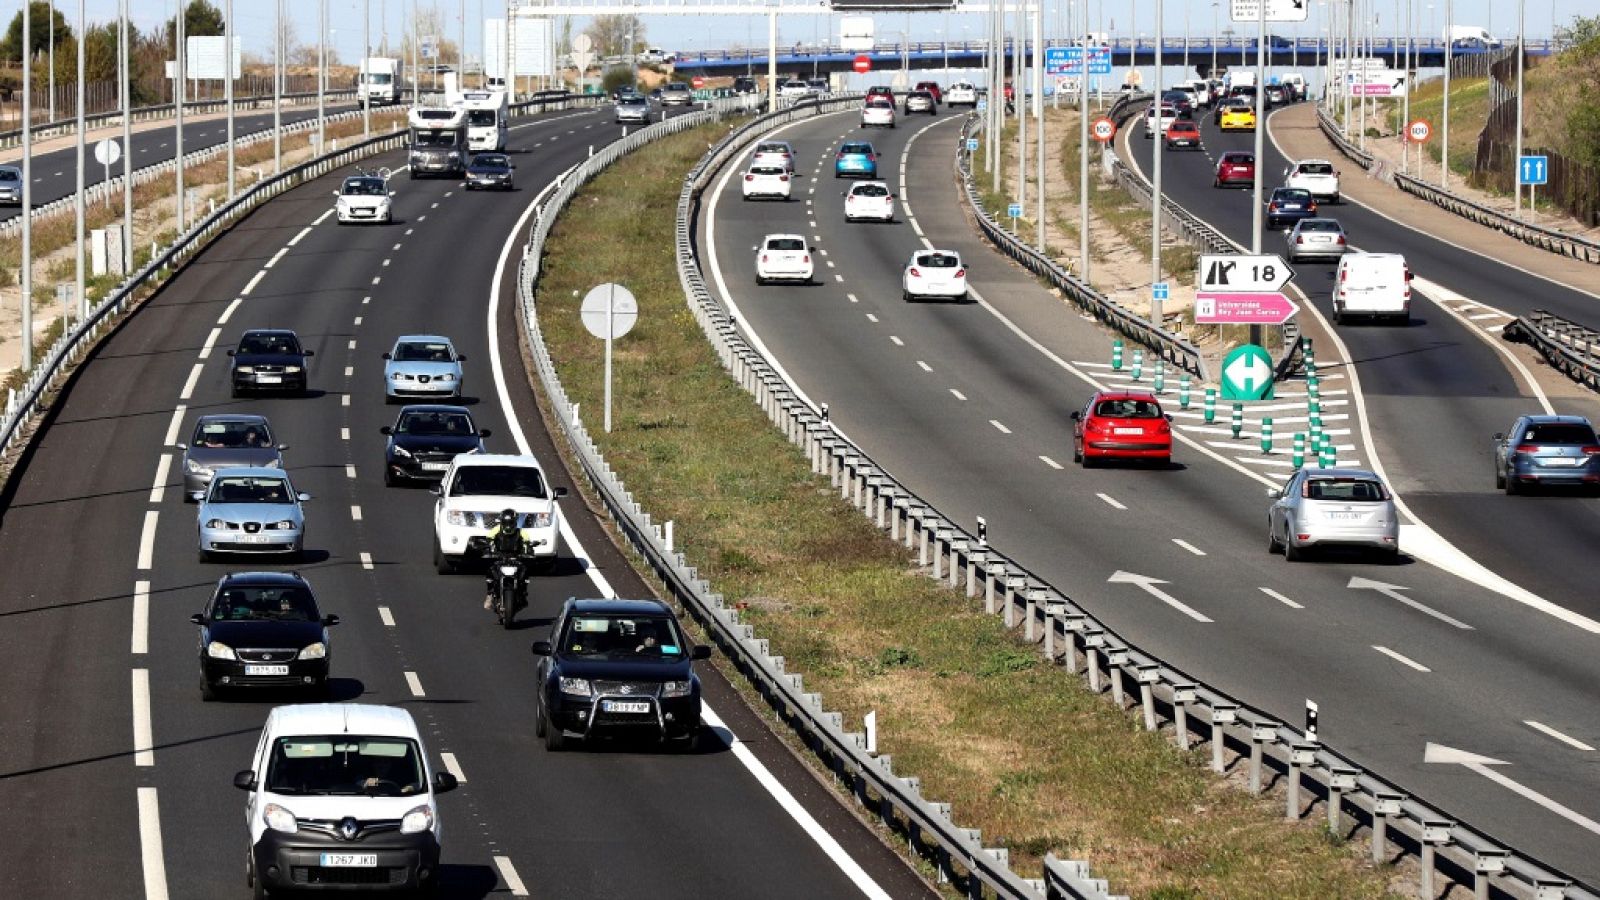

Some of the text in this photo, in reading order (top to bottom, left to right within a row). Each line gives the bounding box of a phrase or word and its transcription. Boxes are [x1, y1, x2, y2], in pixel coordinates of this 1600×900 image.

[1096, 125, 1112, 134] 100
[1412, 127, 1427, 135] 100
[1252, 265, 1276, 282] 18
[1218, 301, 1260, 309] Universidad
[1218, 308, 1280, 317] Rey Juan Carlos
[329, 855, 354, 865] 1267
